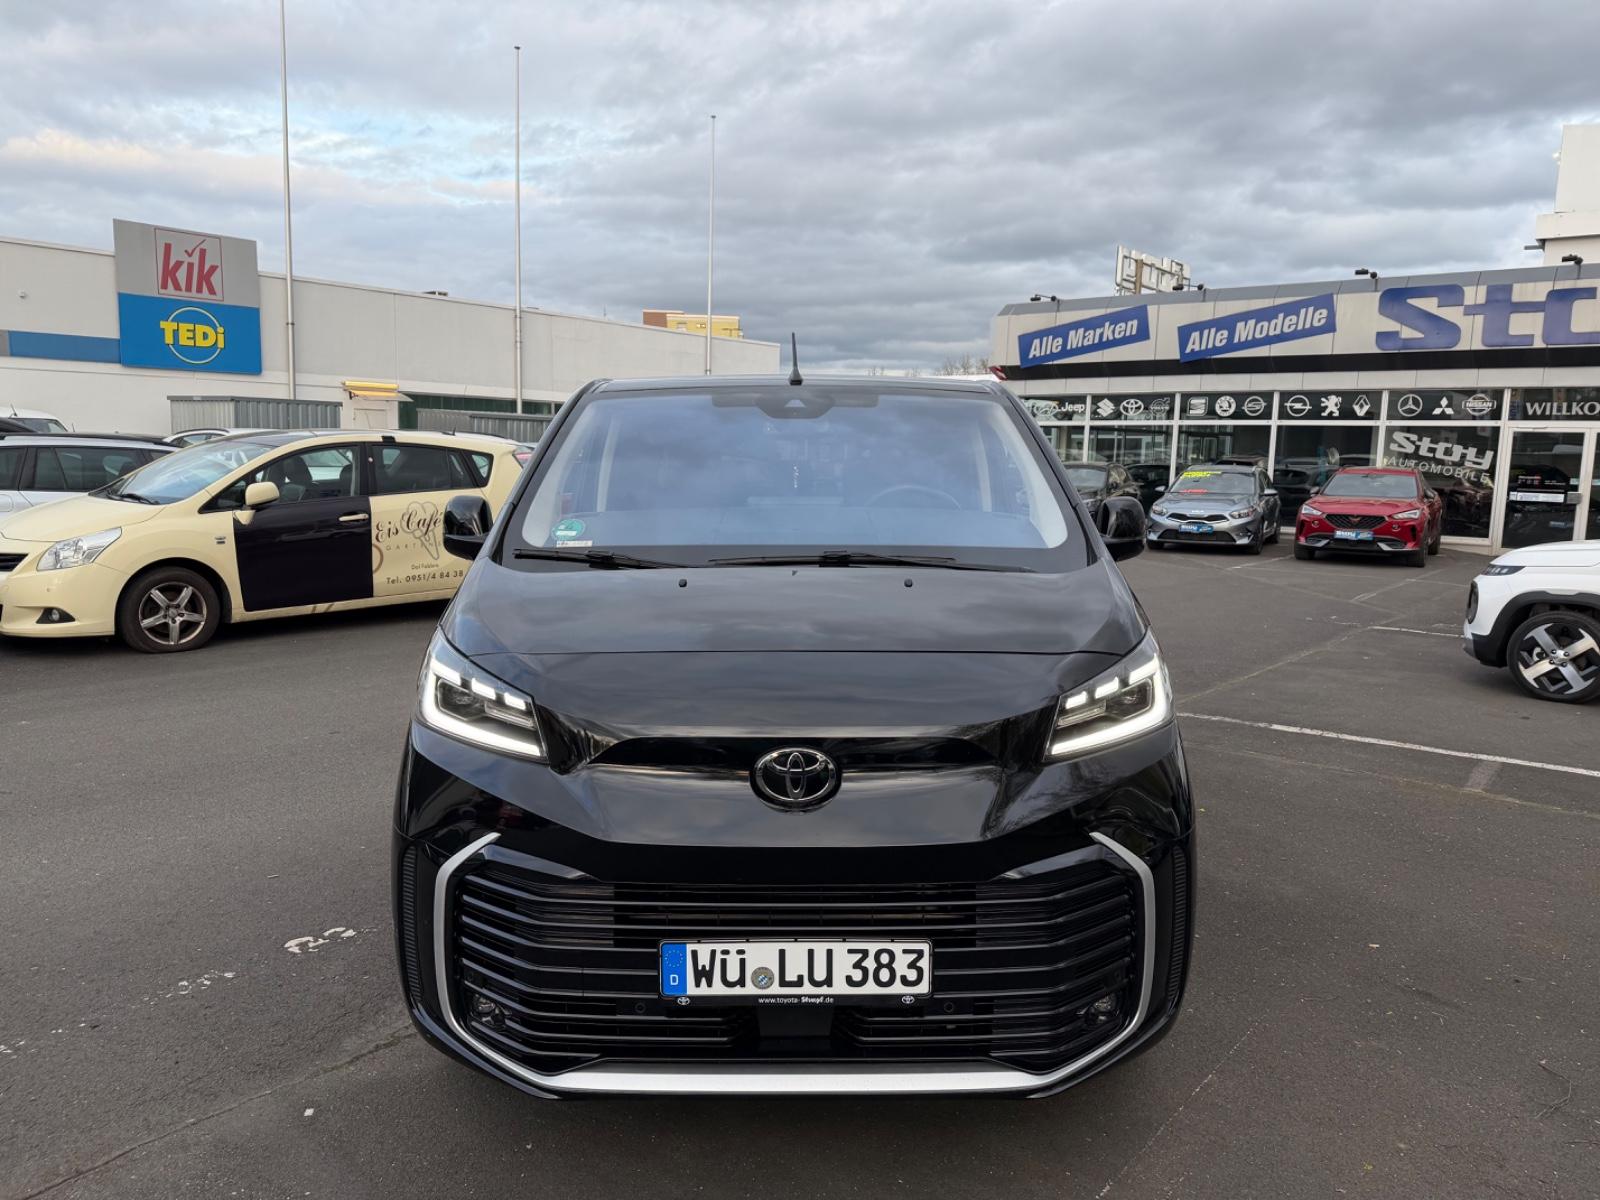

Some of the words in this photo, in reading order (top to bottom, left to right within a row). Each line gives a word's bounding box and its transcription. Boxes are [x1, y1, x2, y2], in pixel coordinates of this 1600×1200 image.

[160, 321, 225, 349] TEDi
[1028, 336, 1062, 359] Alle
[1066, 319, 1138, 350] Marken
[1185, 326, 1228, 354] Alle
[1233, 306, 1329, 343] Modelle
[1061, 402, 1085, 413] Jeep
[1389, 431, 1494, 470] Stoy
[1388, 456, 1491, 483] AUTOMOBILE
[375, 521, 399, 543] Eis
[402, 509, 443, 536] Café
[386, 576, 402, 584] Tel.
[669, 974, 679, 985] D
[778, 948, 833, 988] LU
[845, 949, 925, 988] 383
